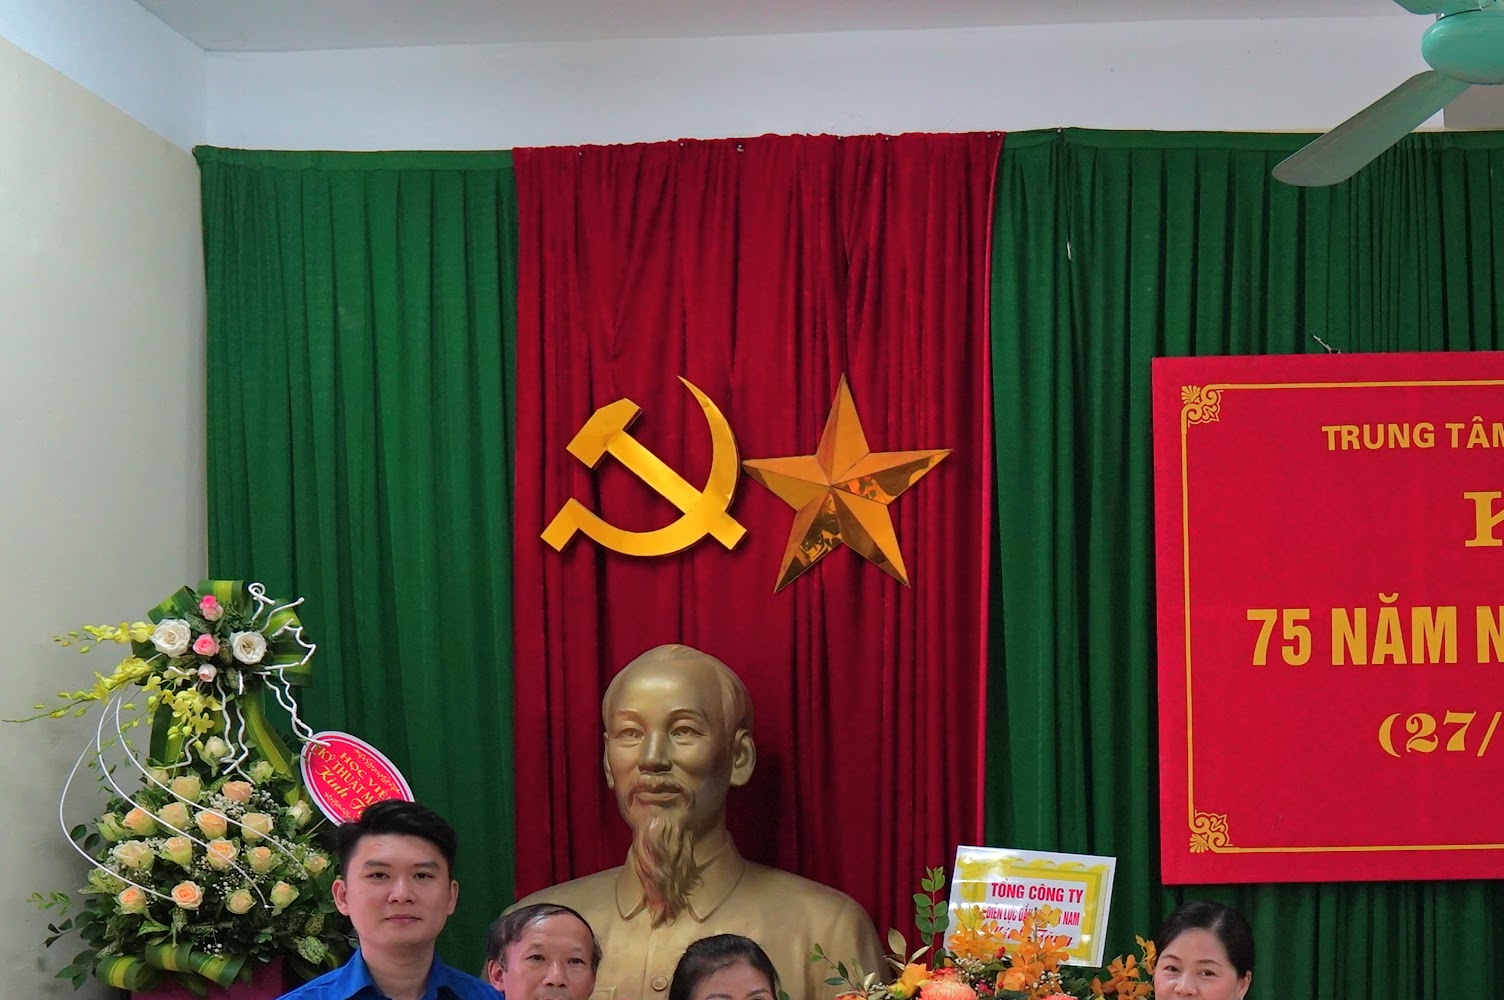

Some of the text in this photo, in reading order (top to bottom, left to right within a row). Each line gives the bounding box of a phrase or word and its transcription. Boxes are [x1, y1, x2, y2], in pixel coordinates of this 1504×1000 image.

[1322, 422, 1436, 451] TRUNG
[1247, 608, 1313, 666] 75
[1331, 592, 1459, 666] NĂM
[368, 777, 393, 801] VIỆ
[991, 877, 1084, 904] TỔNG CÔNG TY
[1062, 911, 1080, 926] NAM
